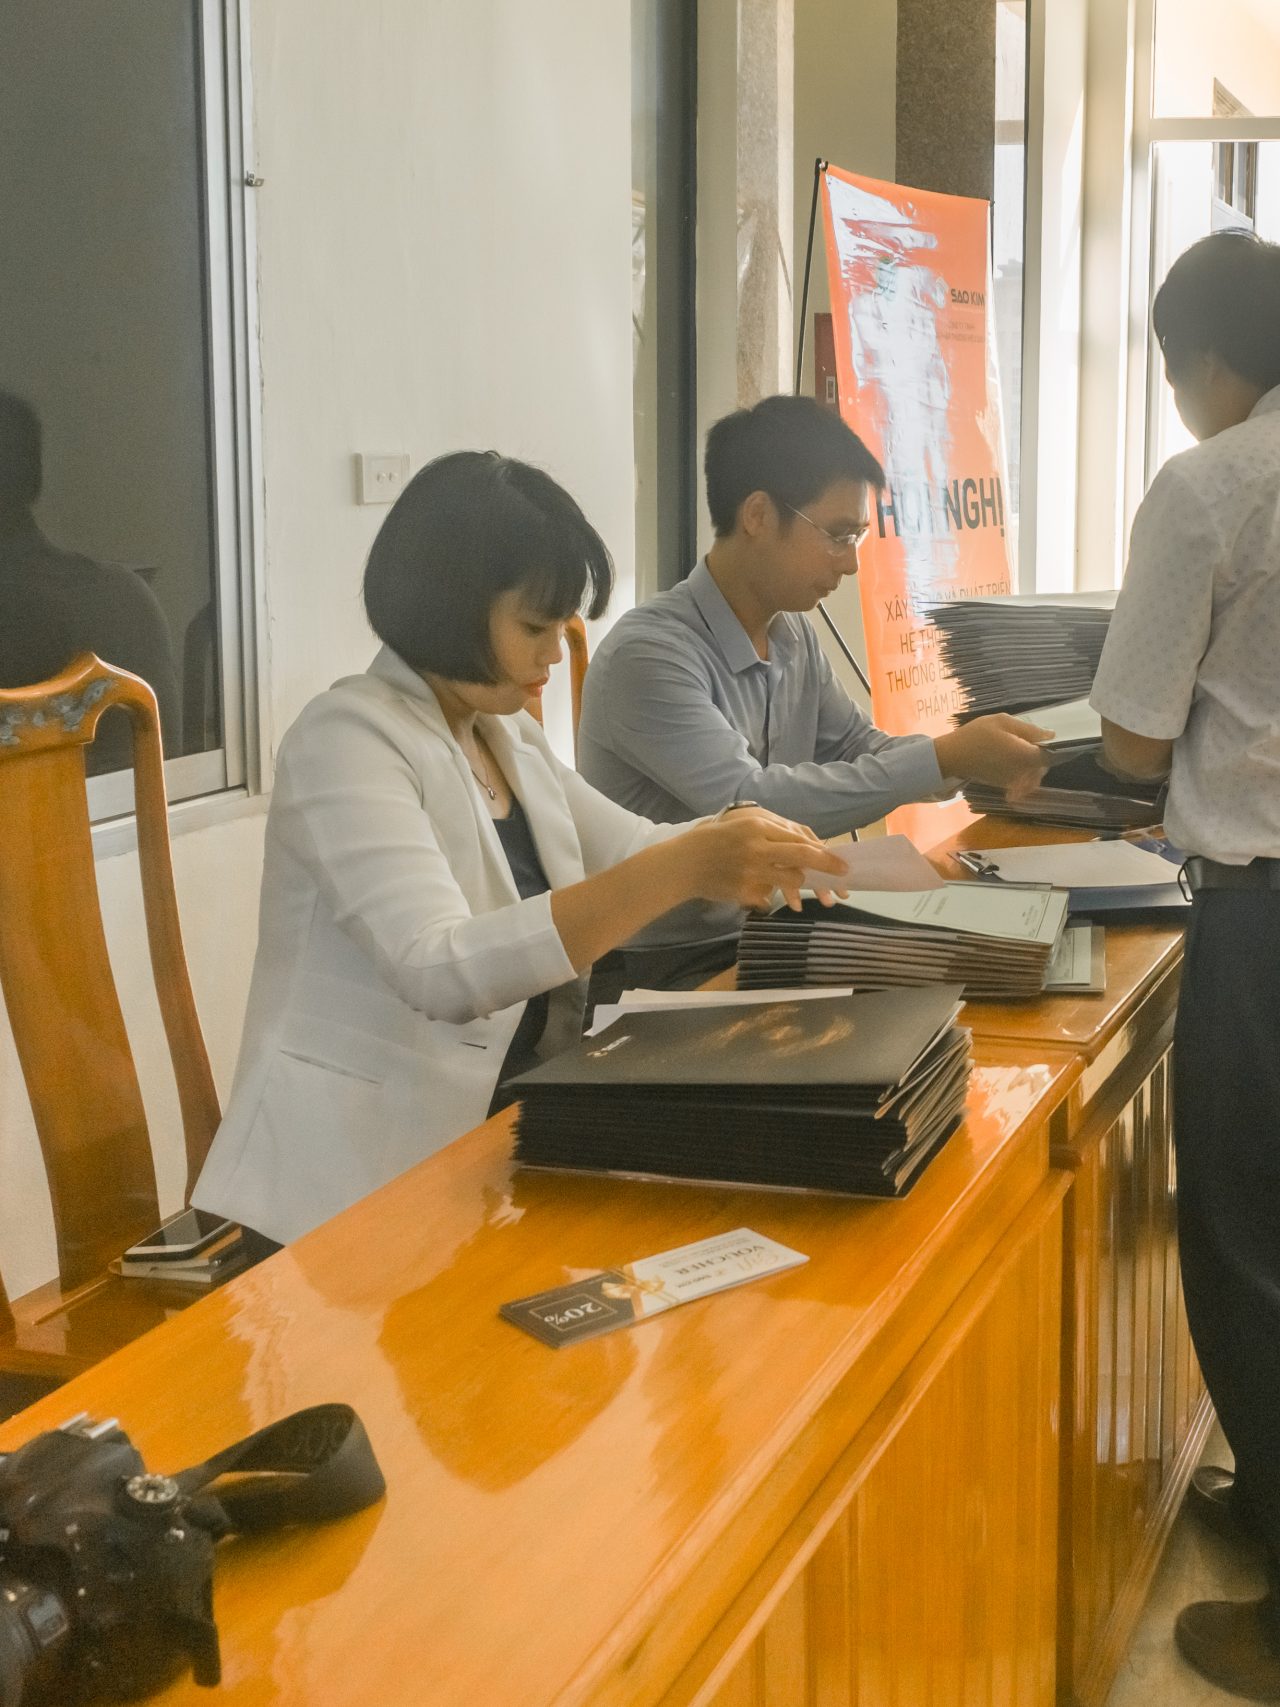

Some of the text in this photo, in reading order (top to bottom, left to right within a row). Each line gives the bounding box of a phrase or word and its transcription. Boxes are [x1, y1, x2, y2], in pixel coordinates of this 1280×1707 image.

[950, 288, 985, 306] SAO KIM
[946, 476, 1006, 538] NGHỊ
[884, 595, 909, 622] XÂY
[675, 1245, 765, 1276] VOUCHER
[544, 1302, 602, 1325] 20%
